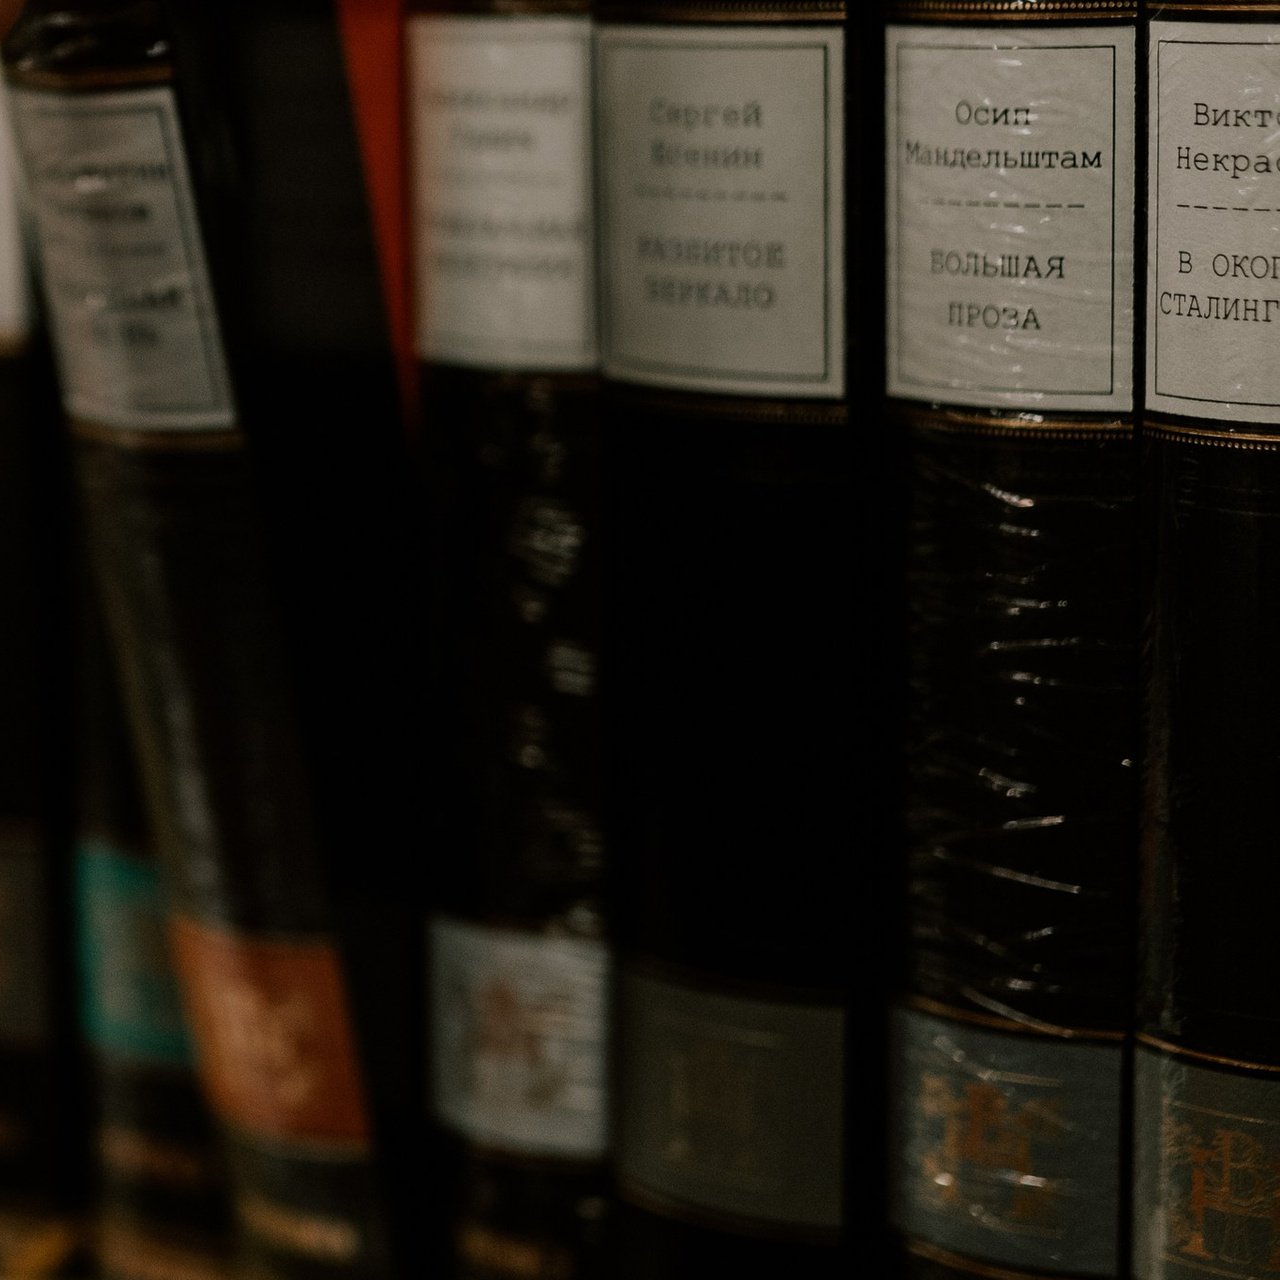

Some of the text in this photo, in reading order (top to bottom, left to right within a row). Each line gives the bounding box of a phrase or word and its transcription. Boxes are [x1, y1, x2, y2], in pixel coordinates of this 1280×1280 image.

[955, 100, 1031, 126] Осип
[1194, 102, 1280, 128] Викт
[905, 142, 1103, 170] Мандельштам
[1177, 146, 1280, 179] Некра
[929, 248, 1066, 279] БОЛЬШАЯ
[1178, 250, 1193, 274] В
[947, 300, 1042, 330] ПРОЗА
[1160, 291, 1280, 323] СТАЛИНГ
